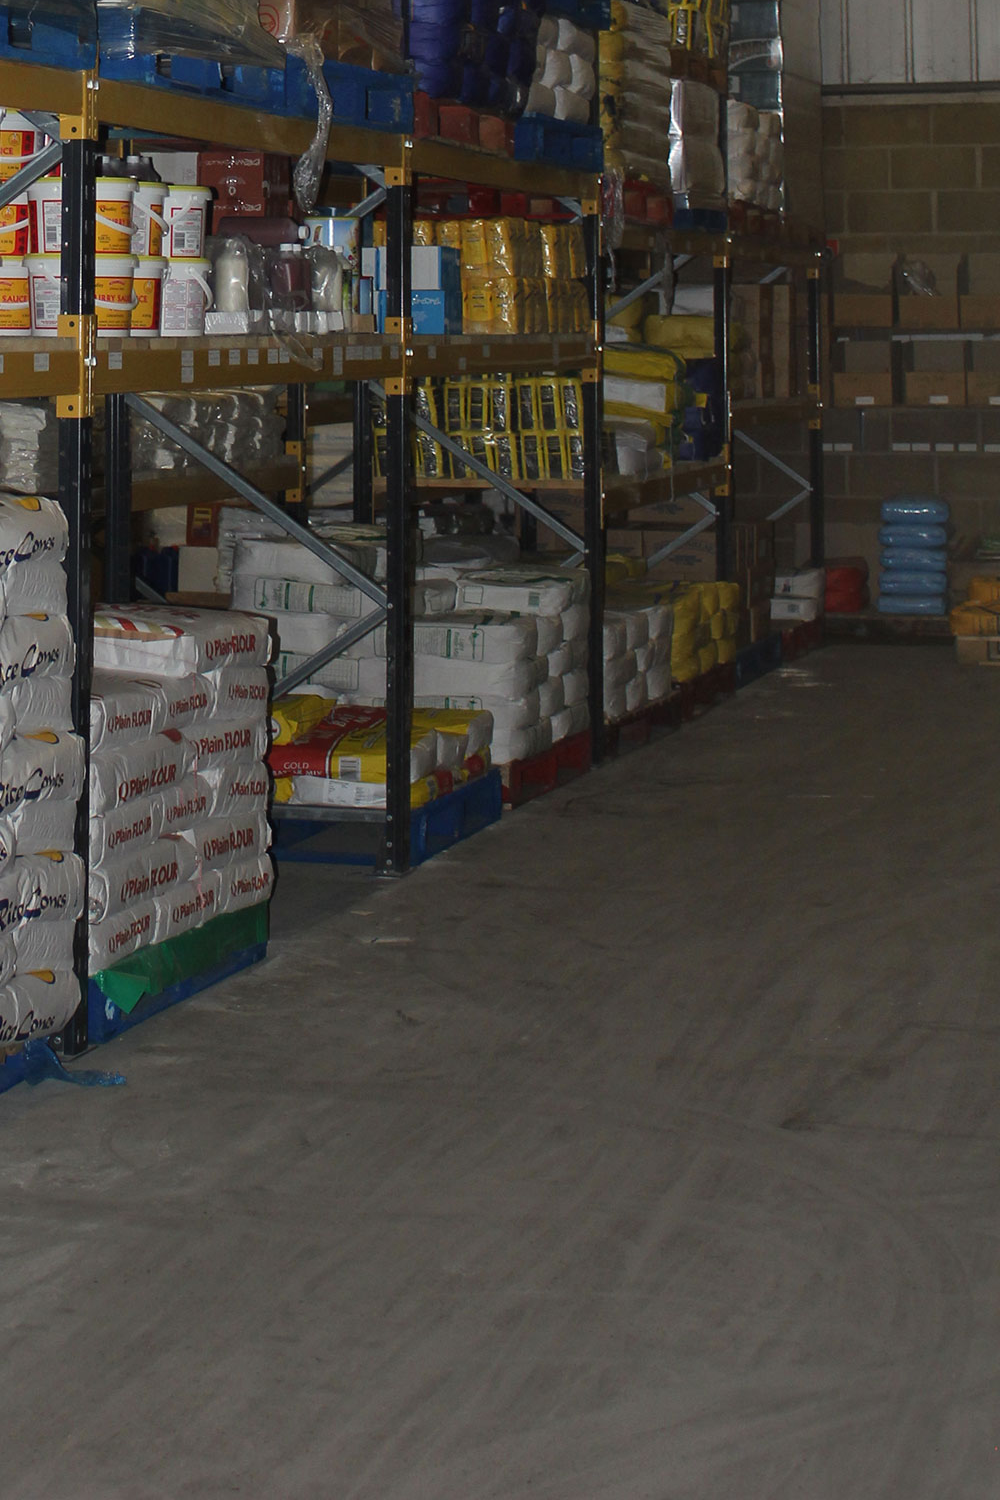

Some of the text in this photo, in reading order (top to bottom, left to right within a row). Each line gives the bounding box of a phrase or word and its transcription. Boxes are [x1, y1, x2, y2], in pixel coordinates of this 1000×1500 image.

[14, 532, 55, 562] Cones
[214, 634, 256, 657] Plain FLOUR
[200, 728, 251, 755] Plain FLOUR
[283, 761, 310, 770] GOLD
[114, 827, 132, 845] Plain
[211, 836, 230, 857] Plain
[128, 862, 178, 900] Plain FLOUR
[180, 901, 196, 920] Plain
